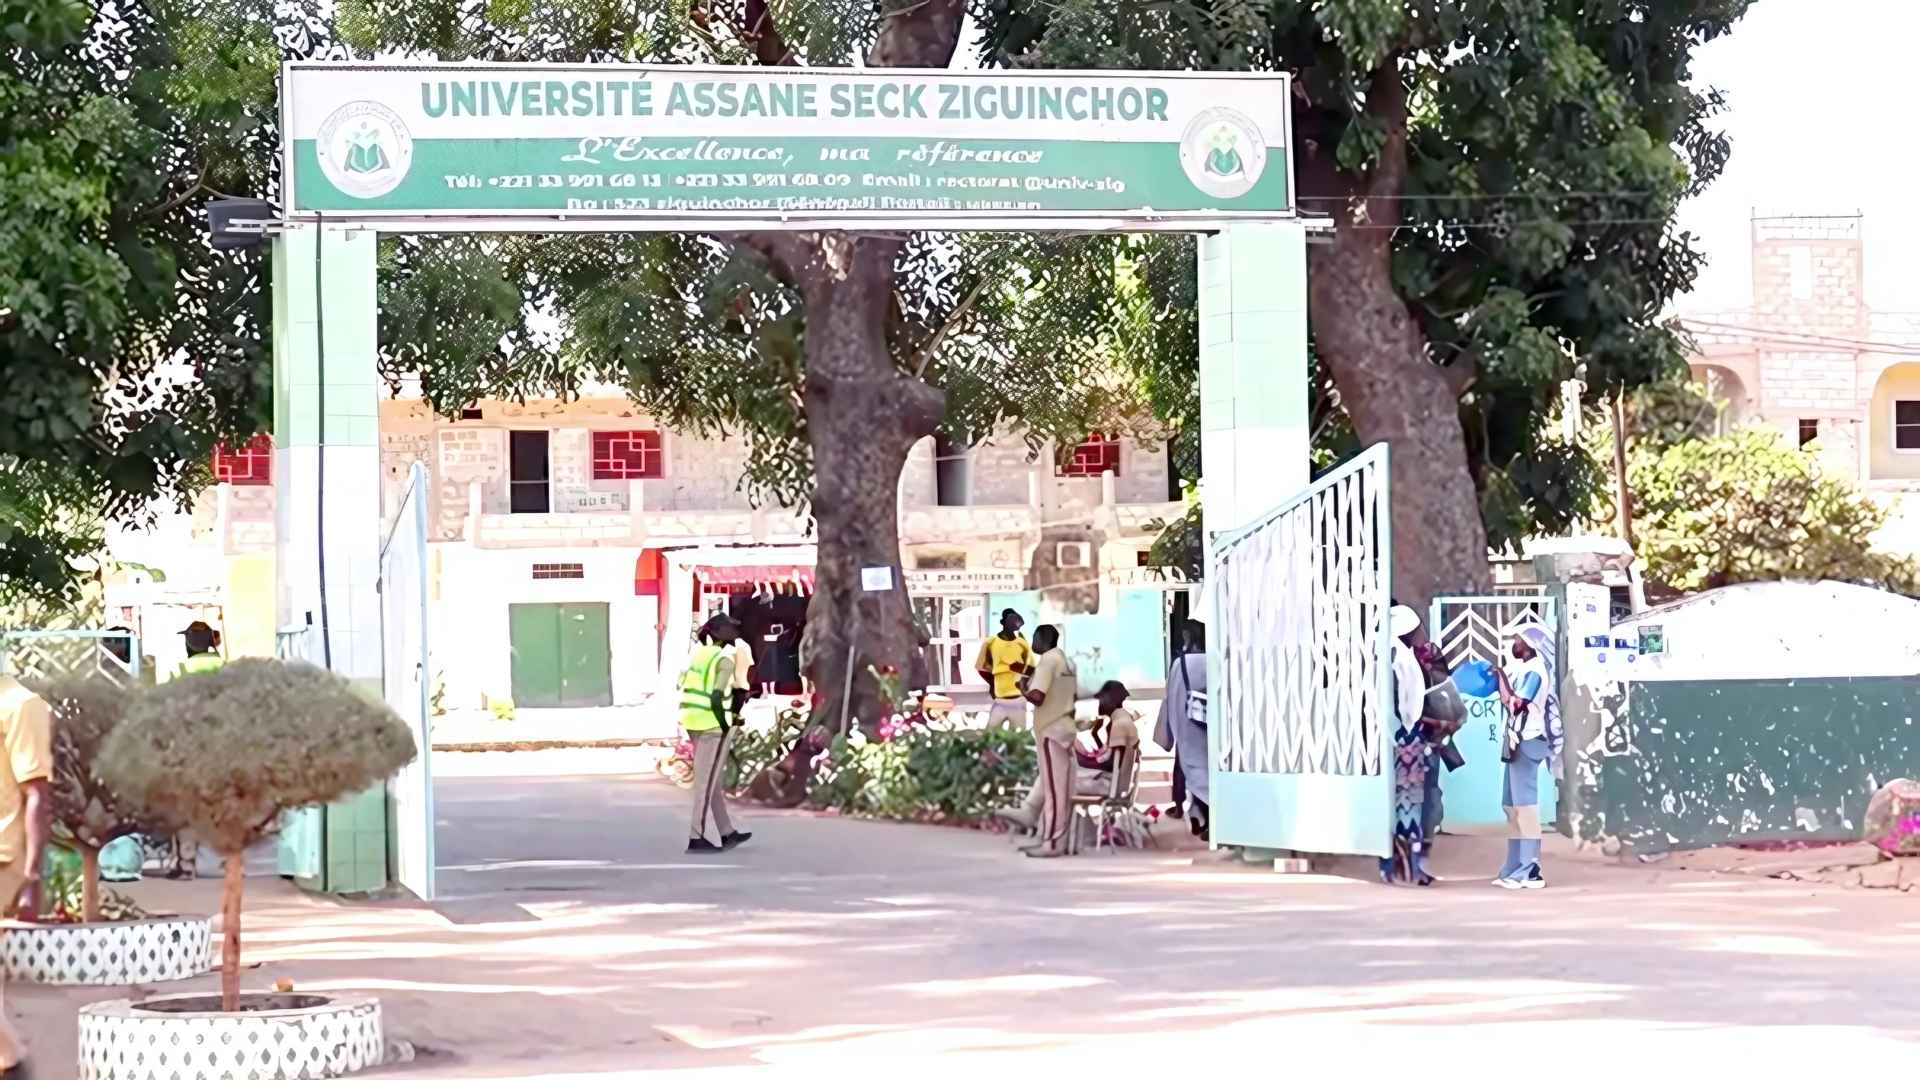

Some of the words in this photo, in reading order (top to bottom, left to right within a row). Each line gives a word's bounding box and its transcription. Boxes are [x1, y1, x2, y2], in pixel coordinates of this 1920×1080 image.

[421, 71, 655, 119] UNIVERSITÉ
[665, 82, 818, 118] ASSANE
[830, 83, 928, 120] SECK
[938, 86, 1170, 122] ZIGUINCHOR
[819, 147, 870, 161] ma
